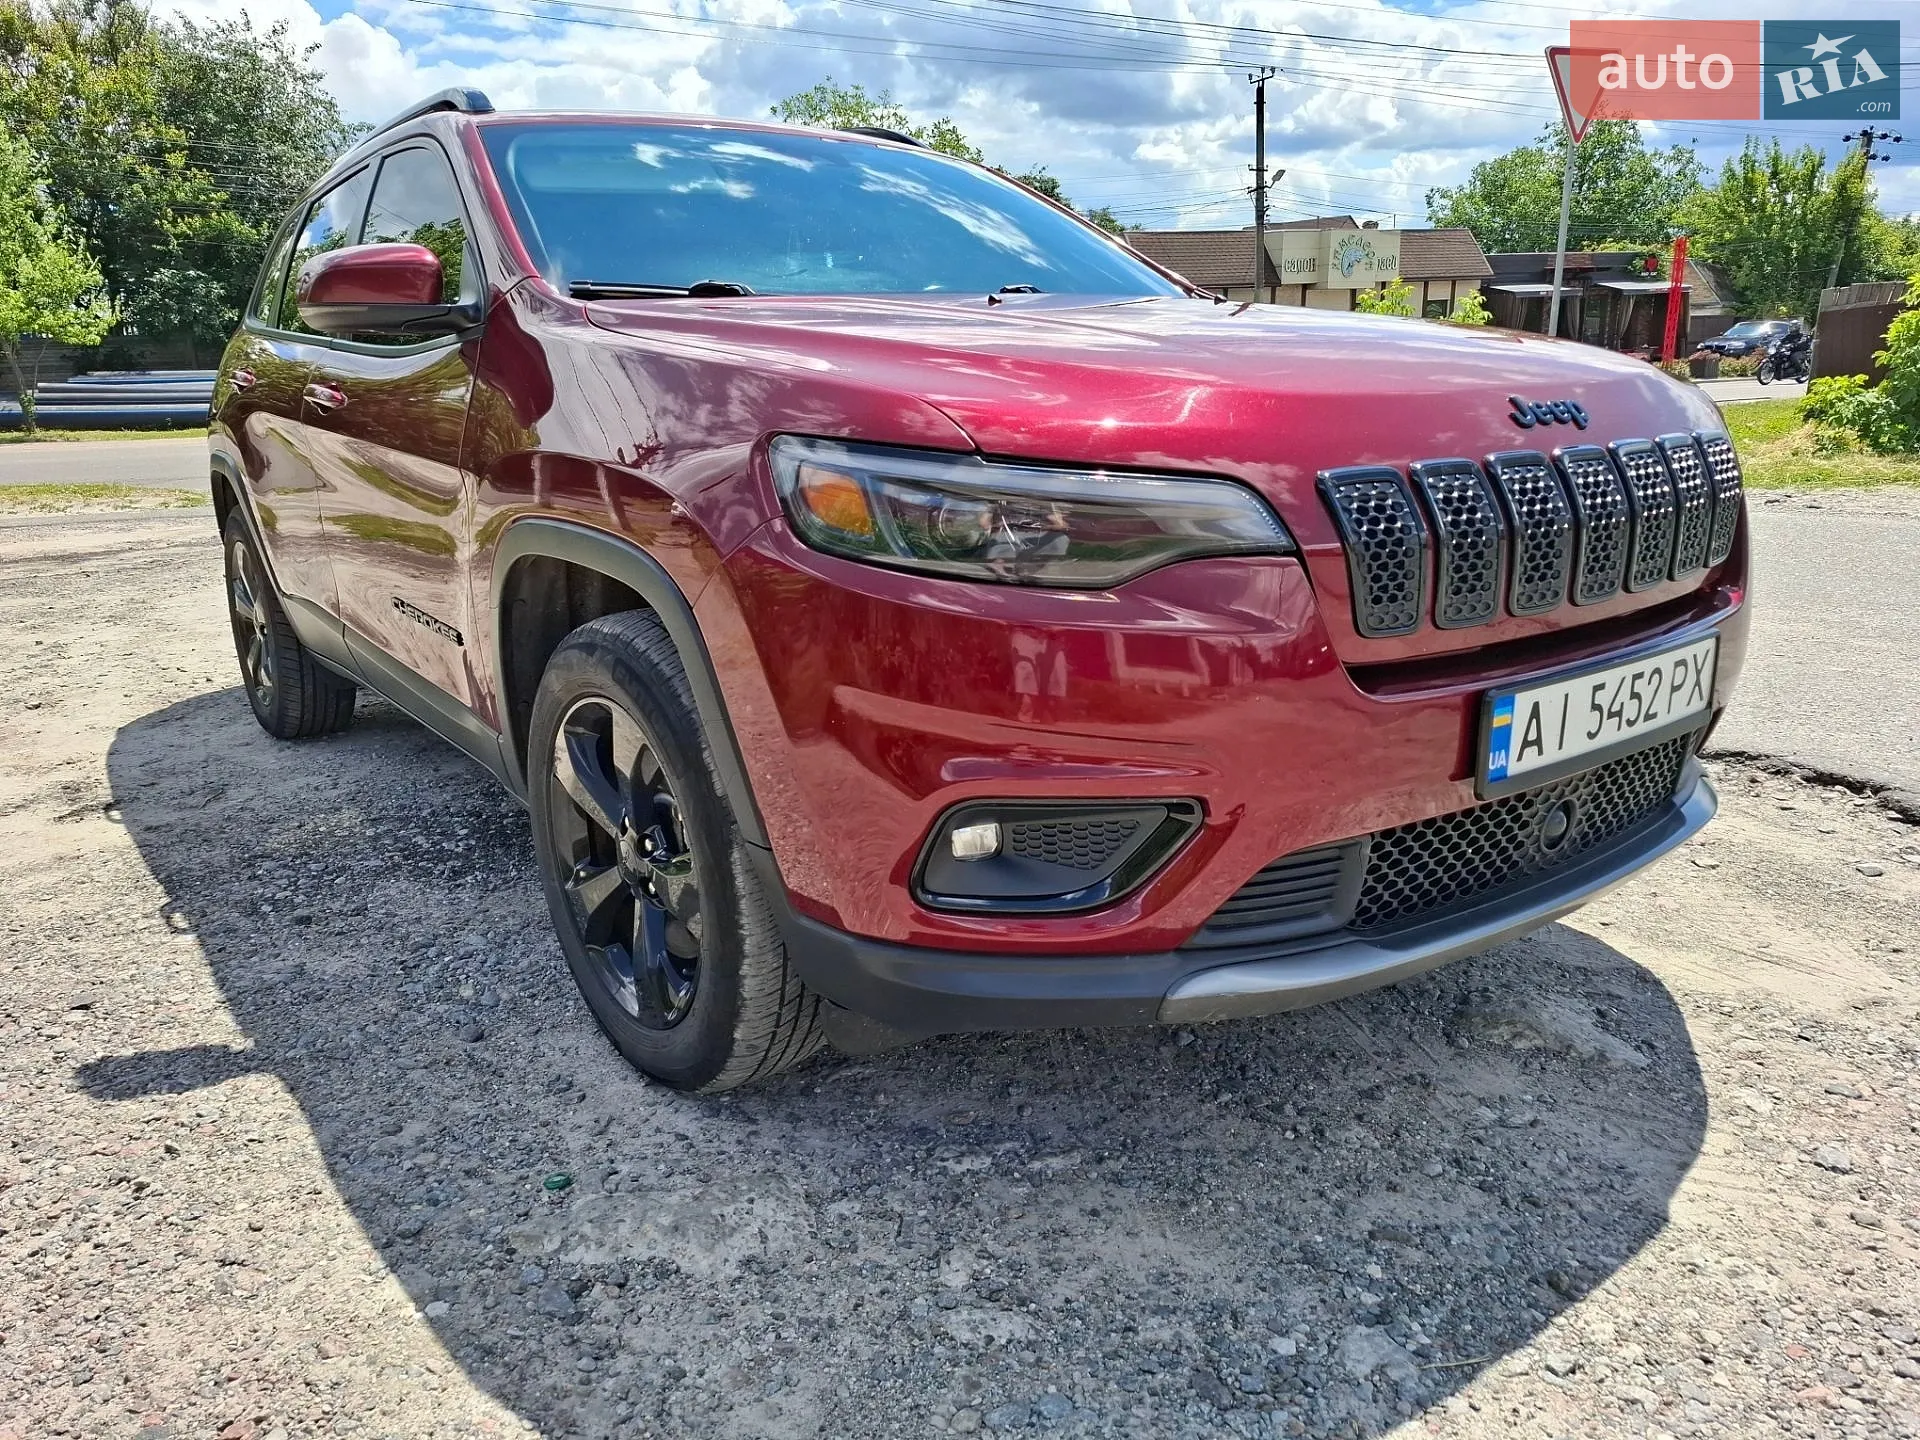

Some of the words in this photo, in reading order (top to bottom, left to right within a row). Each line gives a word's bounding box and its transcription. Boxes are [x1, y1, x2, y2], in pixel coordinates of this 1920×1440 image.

[1507, 395, 1591, 431] Jeep
[1516, 692, 1569, 763] AI
[1586, 666, 1662, 741] 5452
[1667, 648, 1710, 715] PX
[1488, 749, 1507, 770] UA
